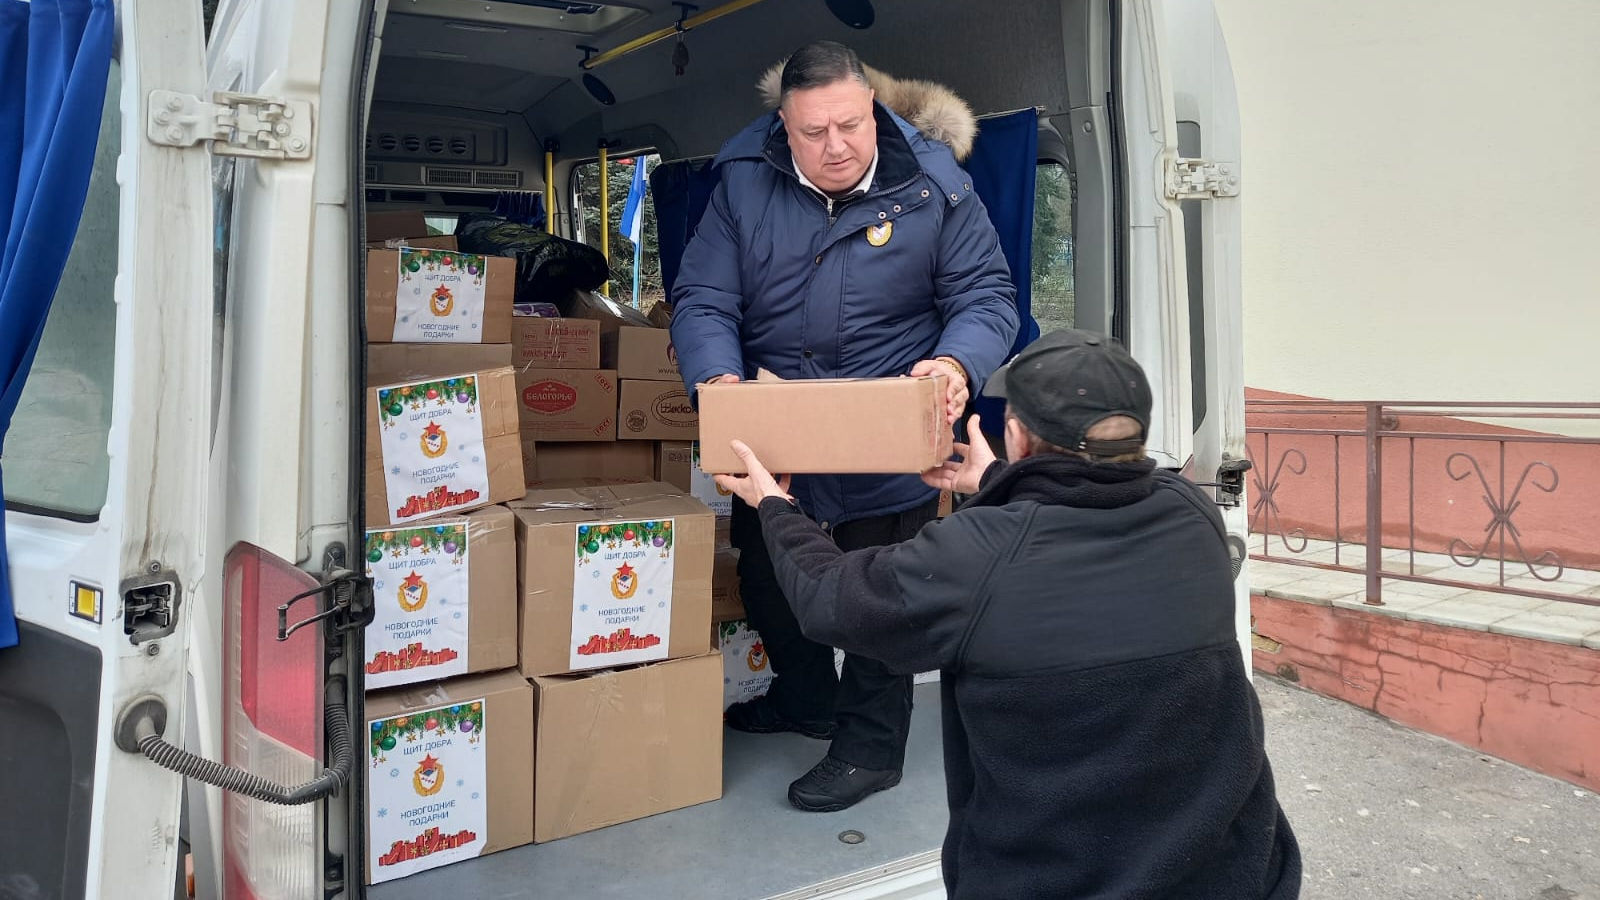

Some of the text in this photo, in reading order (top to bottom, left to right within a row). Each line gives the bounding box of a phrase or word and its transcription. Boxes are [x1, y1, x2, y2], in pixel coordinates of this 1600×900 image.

[440, 274, 461, 282] ДОБРА
[417, 323, 460, 331] НОВОГОДНИЕ
[423, 331, 454, 339] ПОДАРКИ
[526, 392, 573, 401] БЕЛОГОРЬЕ
[409, 408, 452, 421] ЩИТ ДОБРА
[412, 461, 460, 478] НОВОГОДНИЕ
[420, 472, 455, 484] ПОДАРКИ
[604, 550, 646, 560] ЩИТ ДОБРА
[389, 557, 437, 570] ЩИТ ДОБРА
[598, 605, 646, 616] НОВОГОДНИЕ
[384, 617, 439, 631] НОВОГОДНИЕ
[605, 615, 640, 624] ПОДАРКИ
[392, 628, 432, 640] ПОДАРКИ
[403, 738, 453, 756] ЩИТ ДОБРА
[400, 799, 456, 820] НОВОГОДНИЕ
[408, 810, 449, 826] ПОДАРКИ
